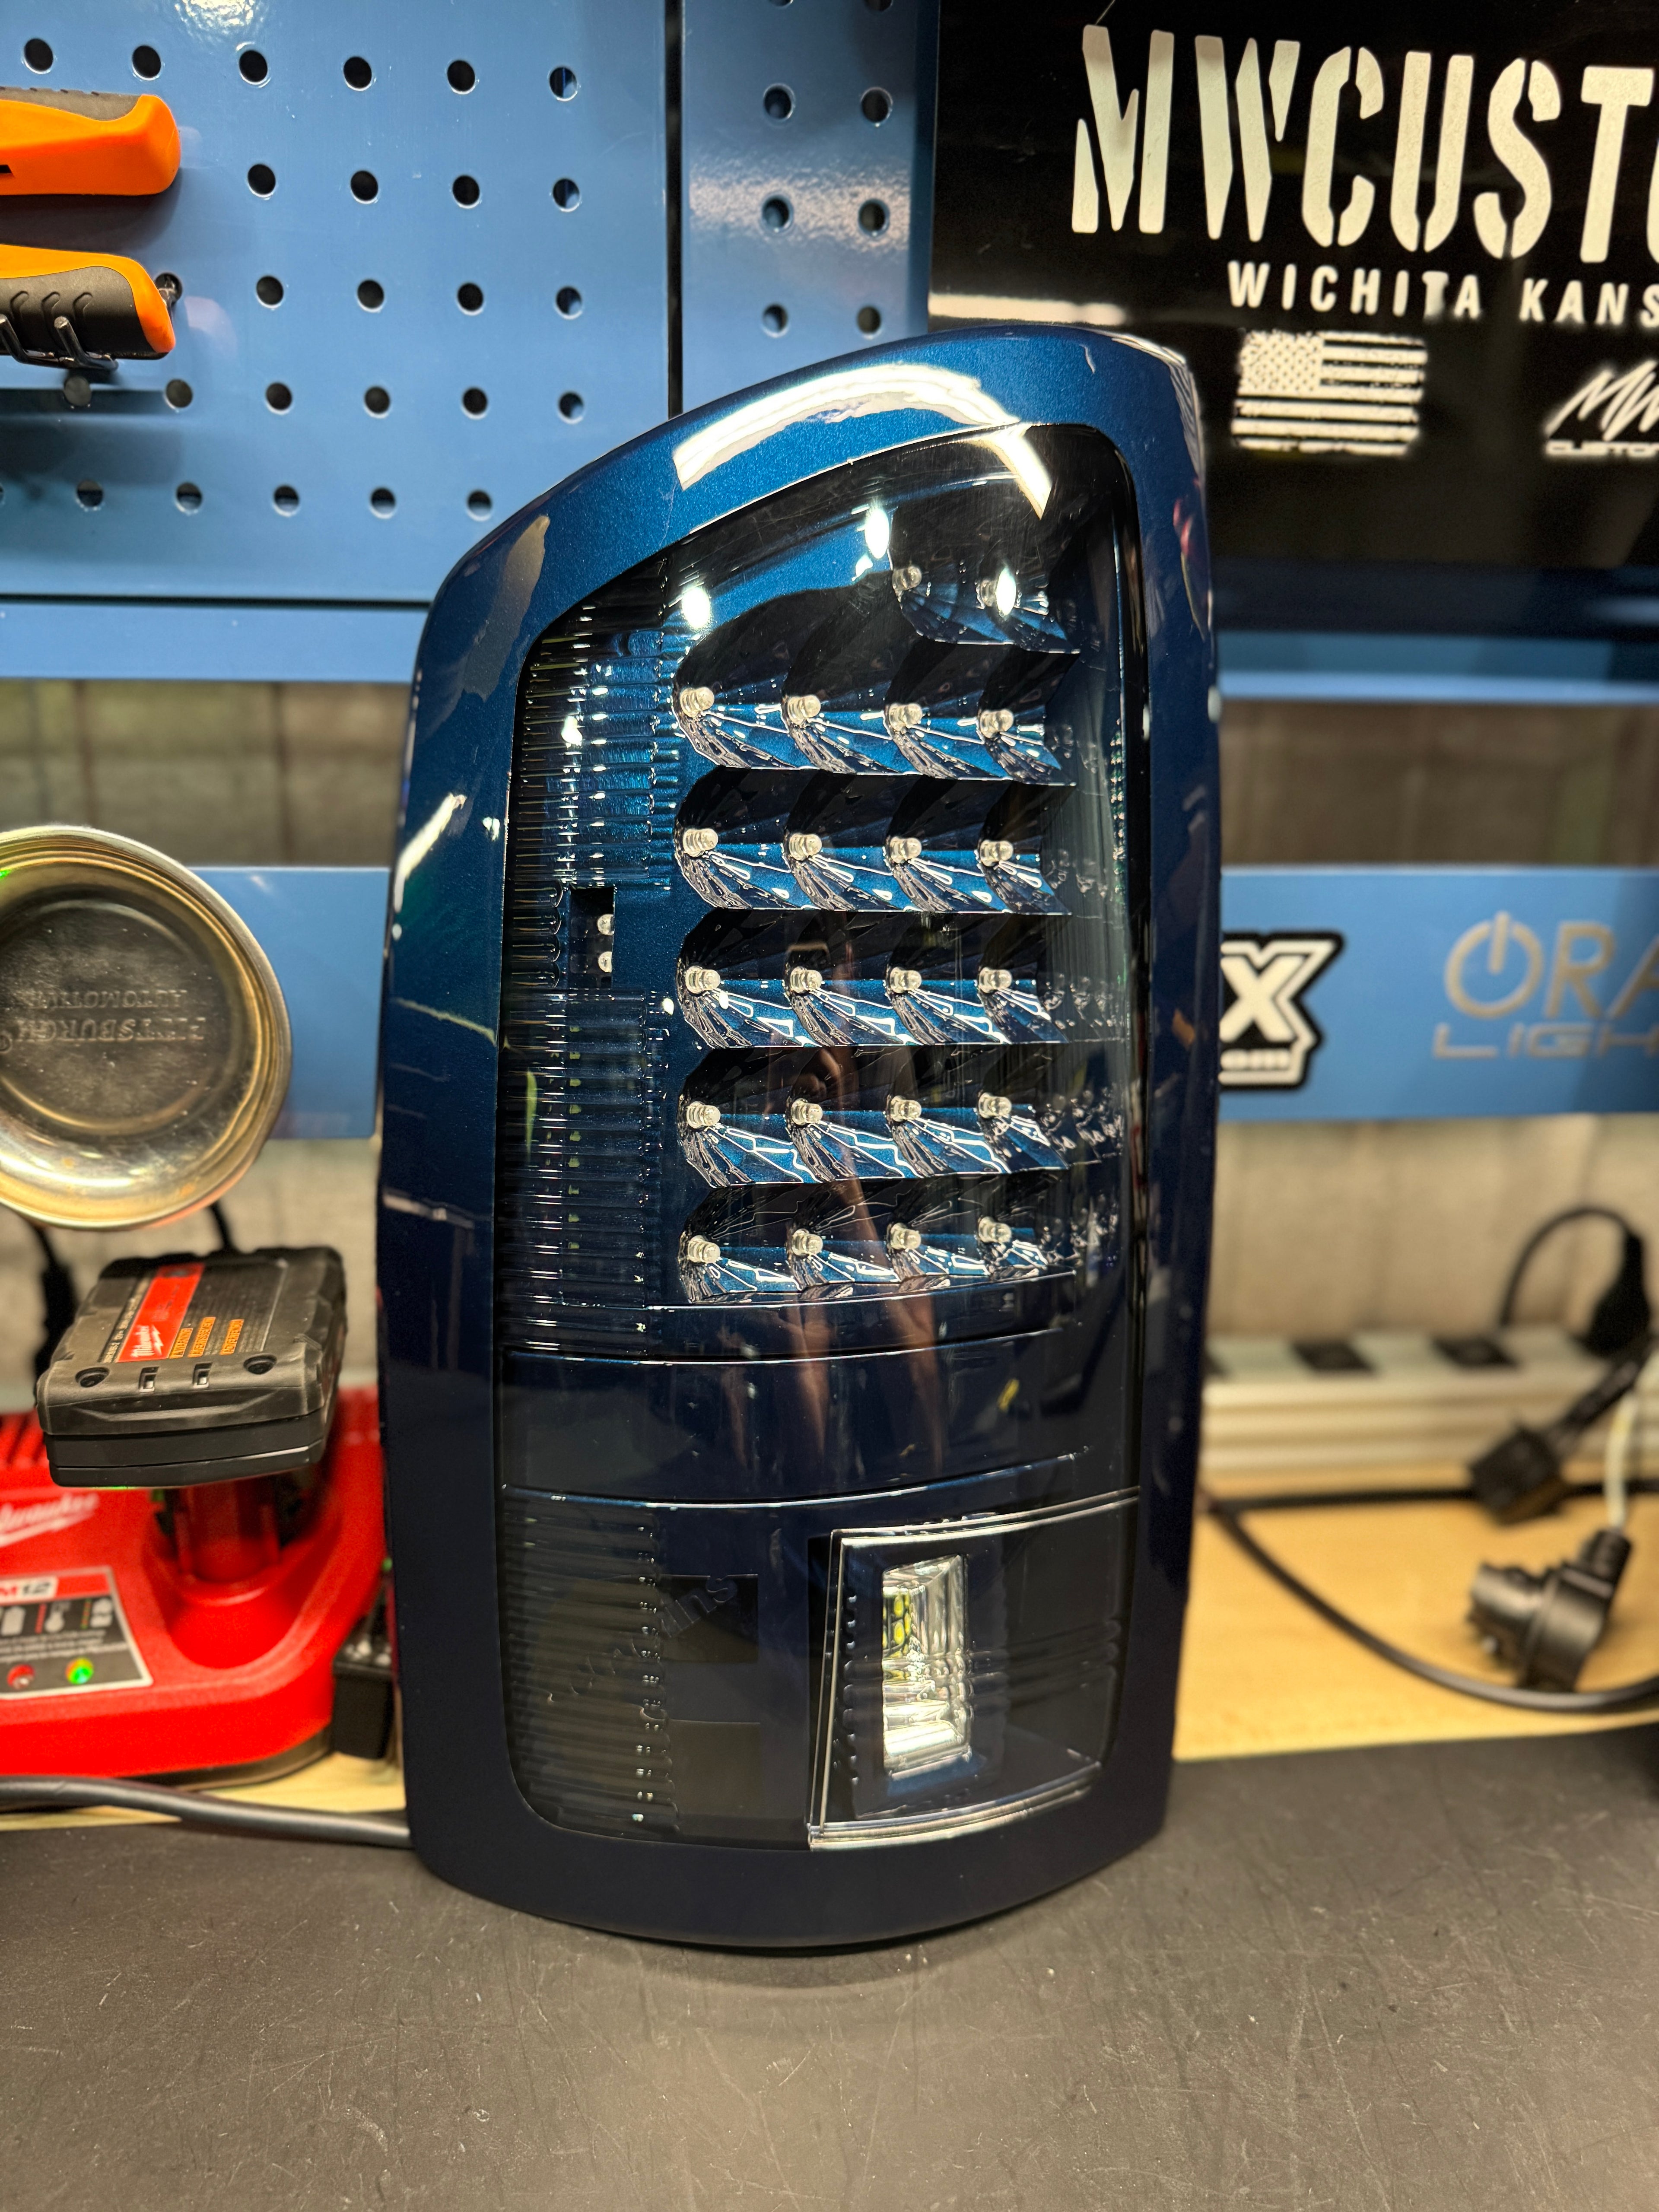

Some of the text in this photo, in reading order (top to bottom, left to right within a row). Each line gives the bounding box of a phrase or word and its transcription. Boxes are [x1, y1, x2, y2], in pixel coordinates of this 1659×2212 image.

[1072, 24, 1659, 263] MWCUST
[1227, 260, 1659, 327] WICHITA KANS
